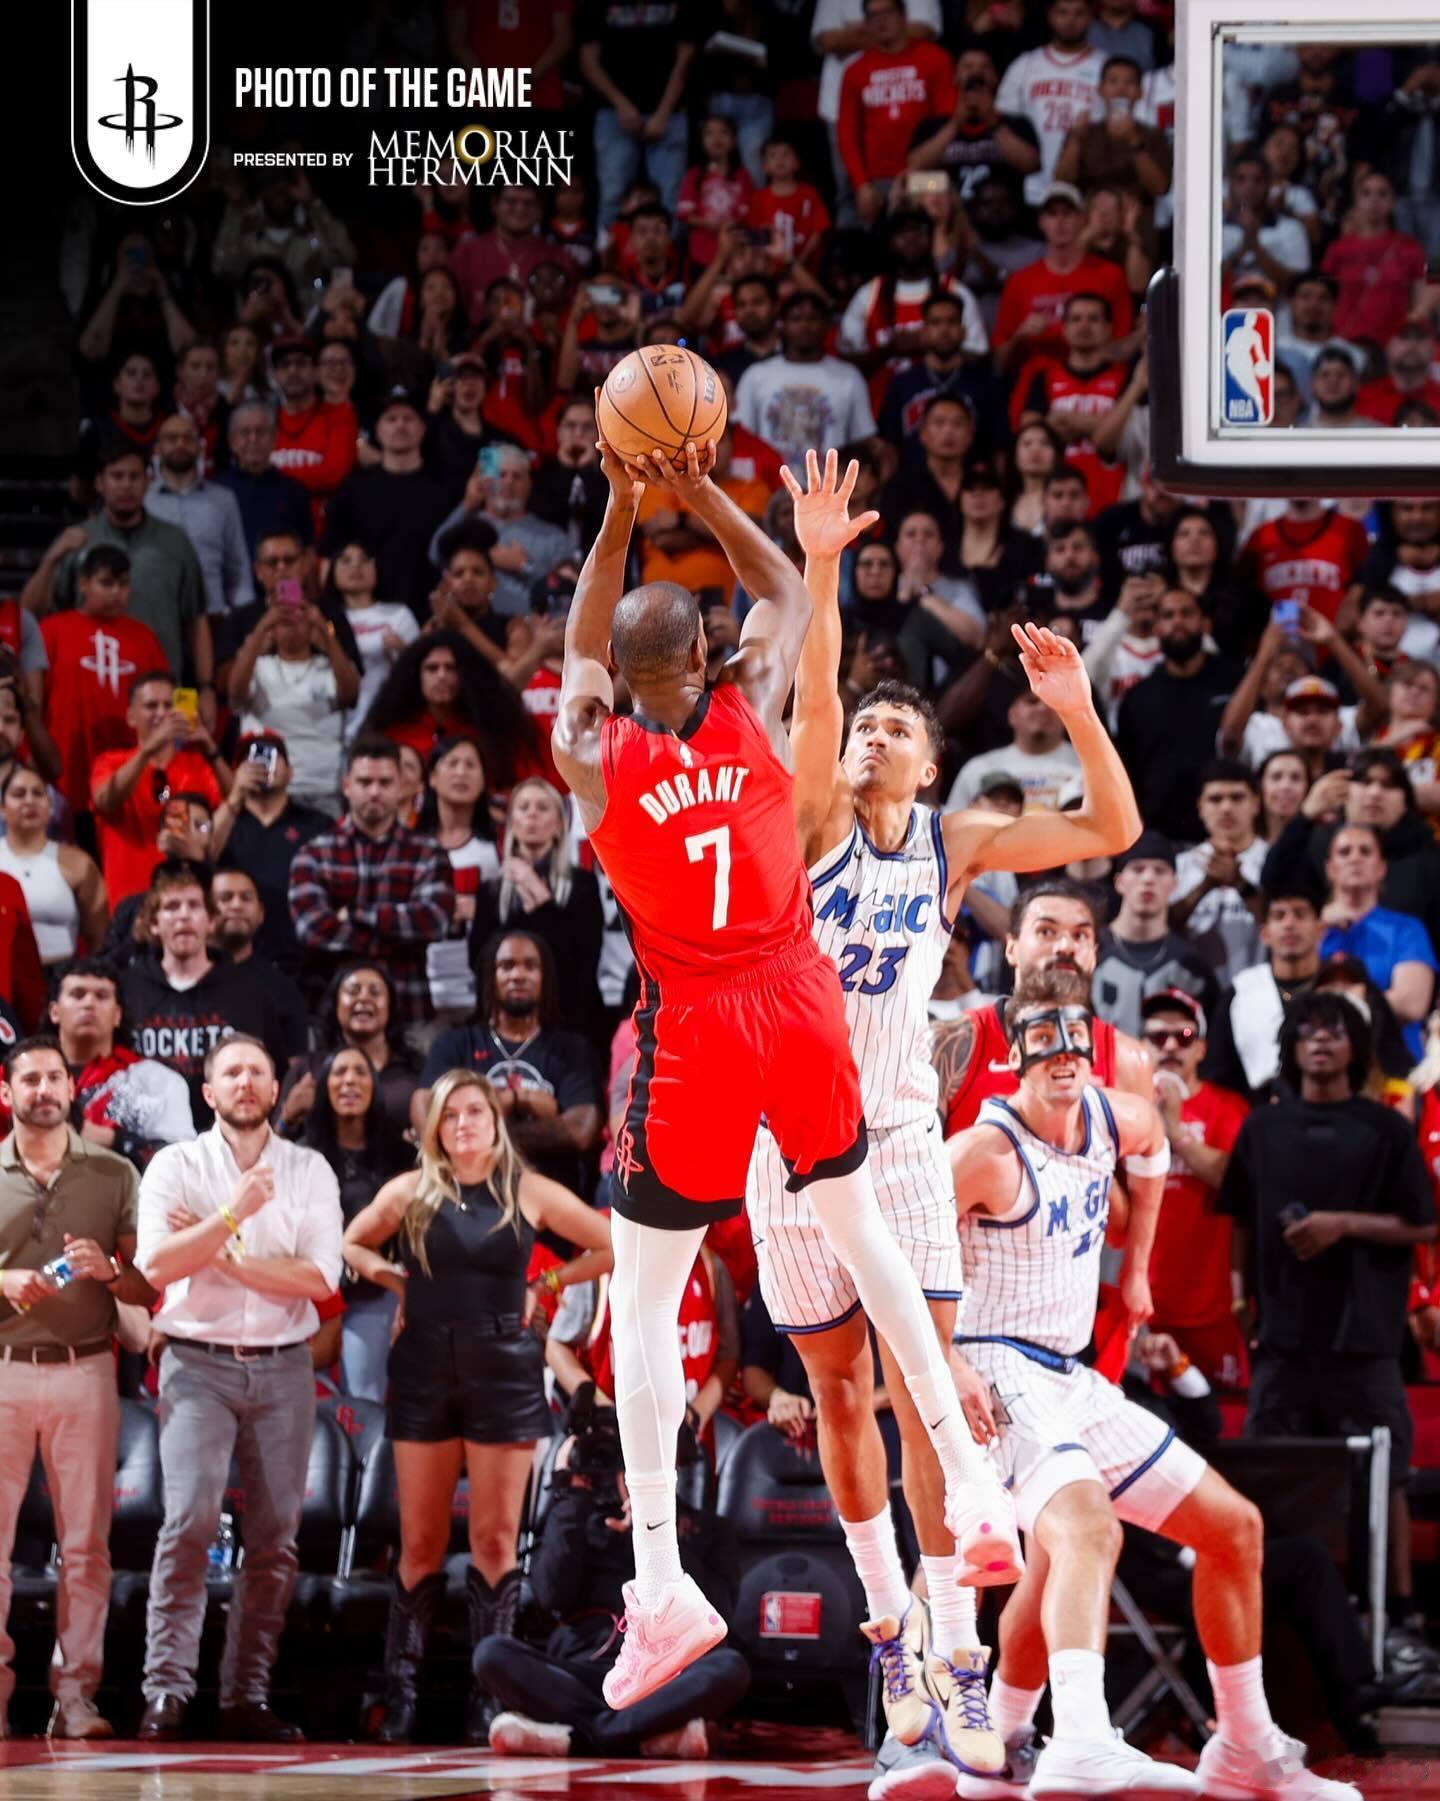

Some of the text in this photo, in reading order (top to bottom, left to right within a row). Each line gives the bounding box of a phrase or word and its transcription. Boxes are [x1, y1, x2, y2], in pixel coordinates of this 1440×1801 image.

[1228, 398, 1254, 419] NBA
[639, 766, 750, 825] DURANT
[684, 825, 731, 930] 7
[839, 943, 910, 996] 23
